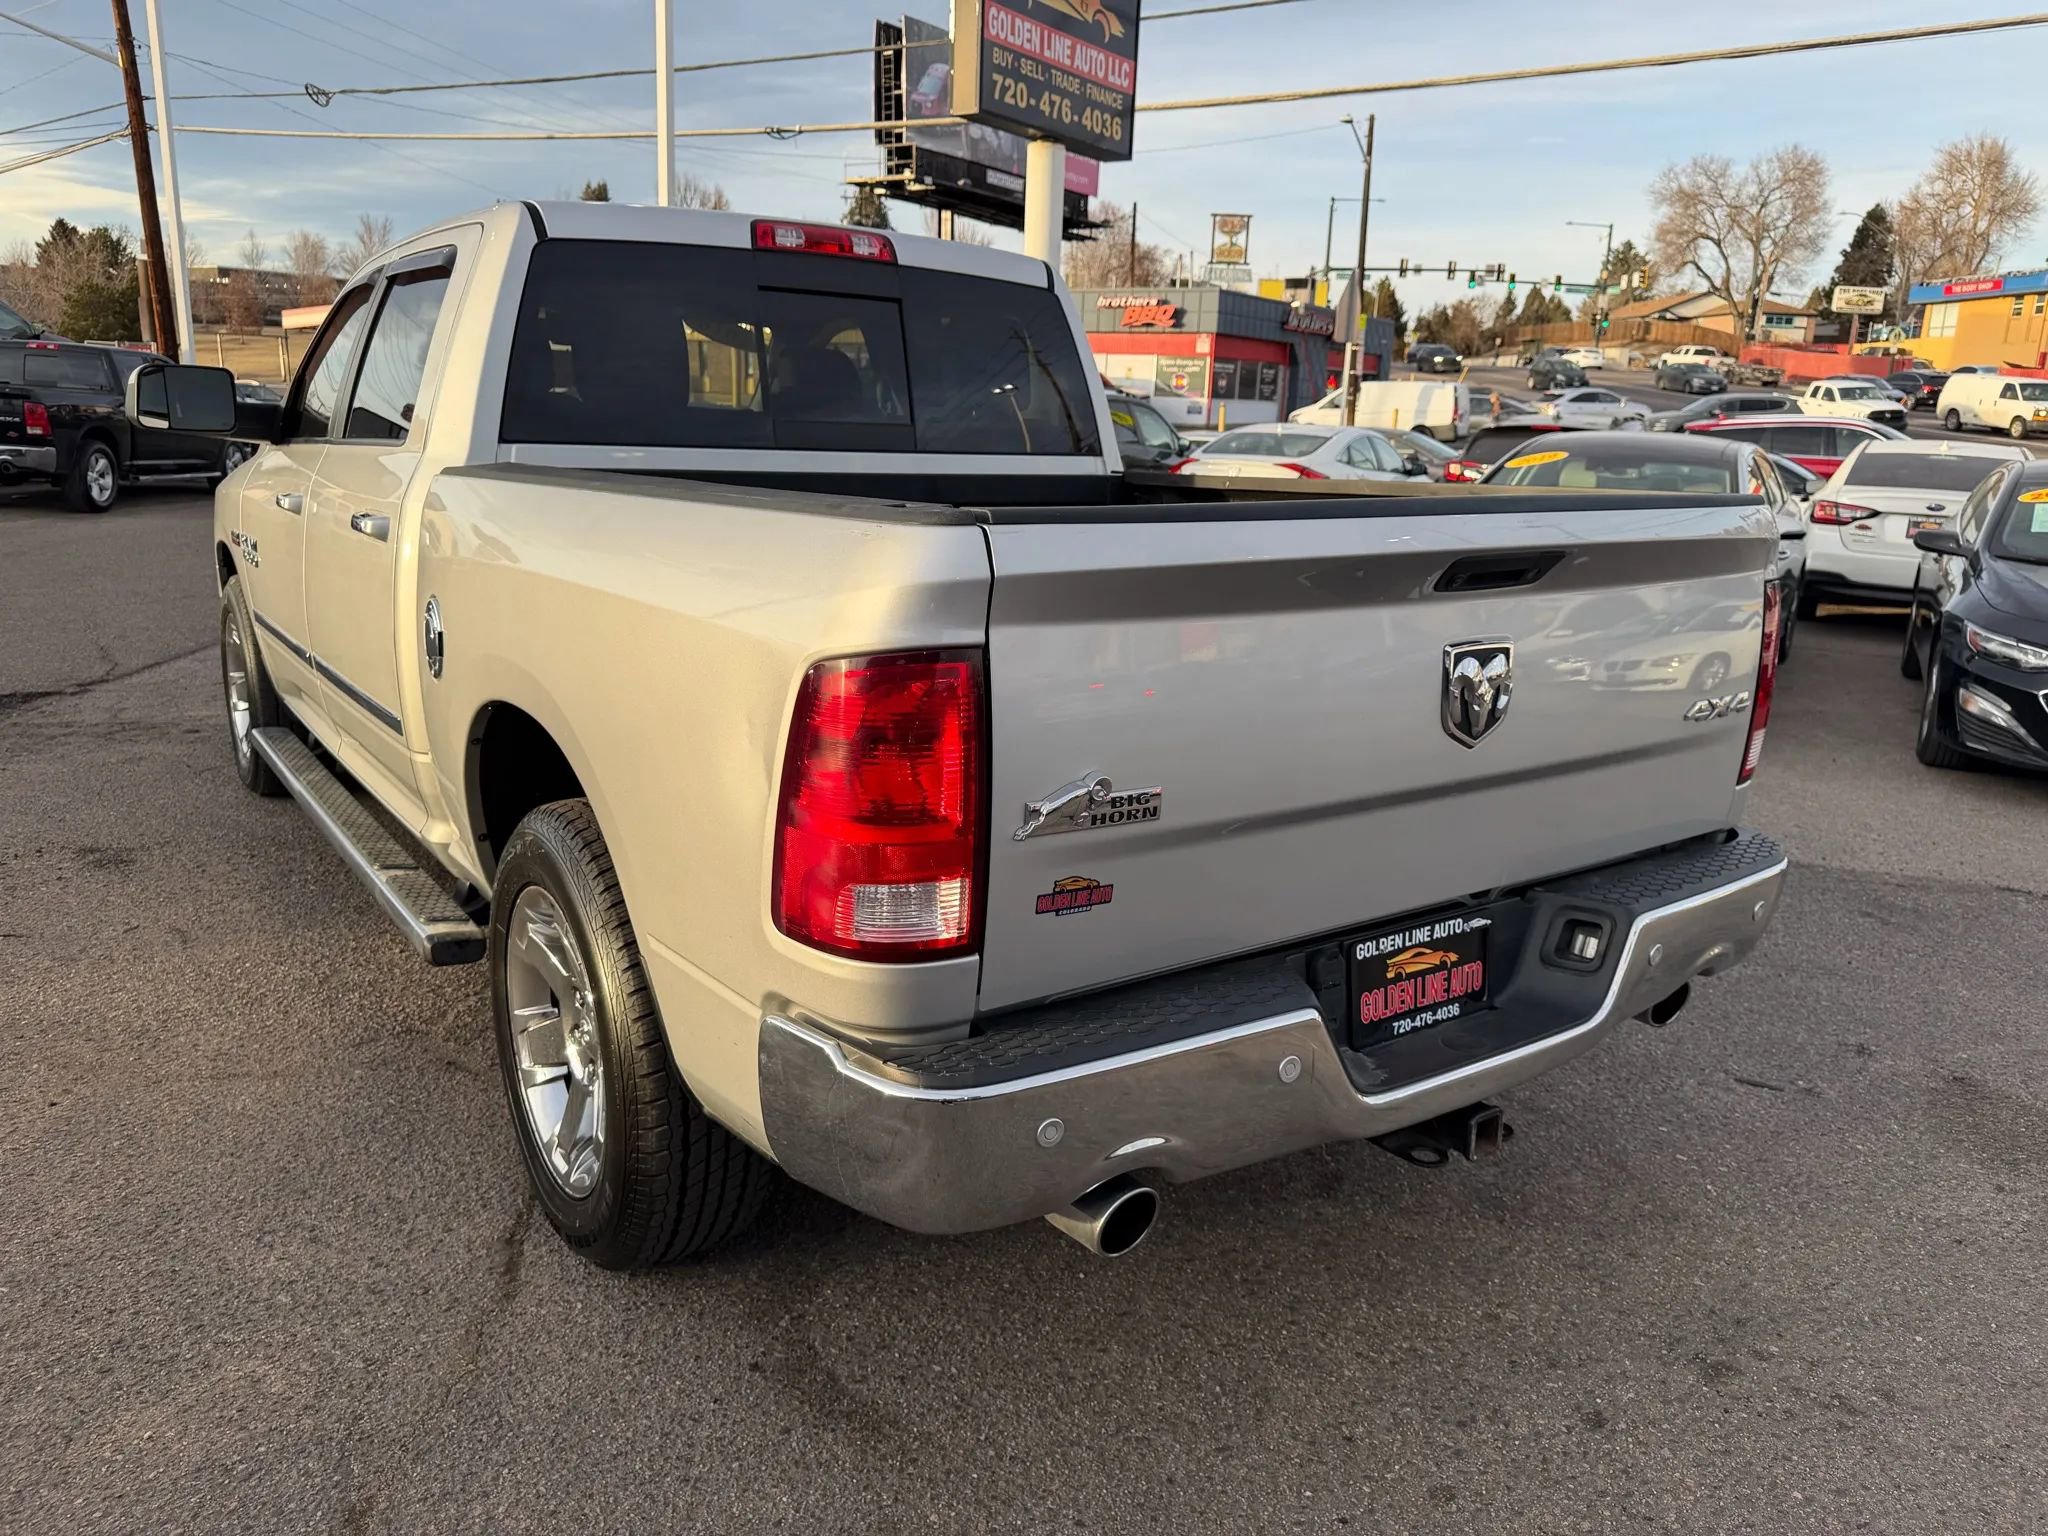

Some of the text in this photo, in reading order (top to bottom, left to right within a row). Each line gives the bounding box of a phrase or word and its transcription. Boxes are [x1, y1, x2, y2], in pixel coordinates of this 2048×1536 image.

[988, 6, 1130, 89] GOLDEN LINE AUTO LLC
[992, 47, 1124, 110] BUY SELL TRADE FINANCE
[992, 73, 1122, 140] 720-476-4036
[1097, 295, 1161, 308] brothers
[1121, 304, 1176, 328] BBQ
[1090, 805, 1158, 826] HORN
[1110, 792, 1151, 810] BIG
[1037, 886, 1112, 913] GOLDEN LINE AUTO
[1058, 905, 1092, 916] COLORADO
[1356, 918, 1463, 960] GOLDEN LINE AUTO
[1360, 961, 1483, 1024] GOLDEN LINE AUTO
[1392, 1003, 1460, 1036] 720-476-4036
